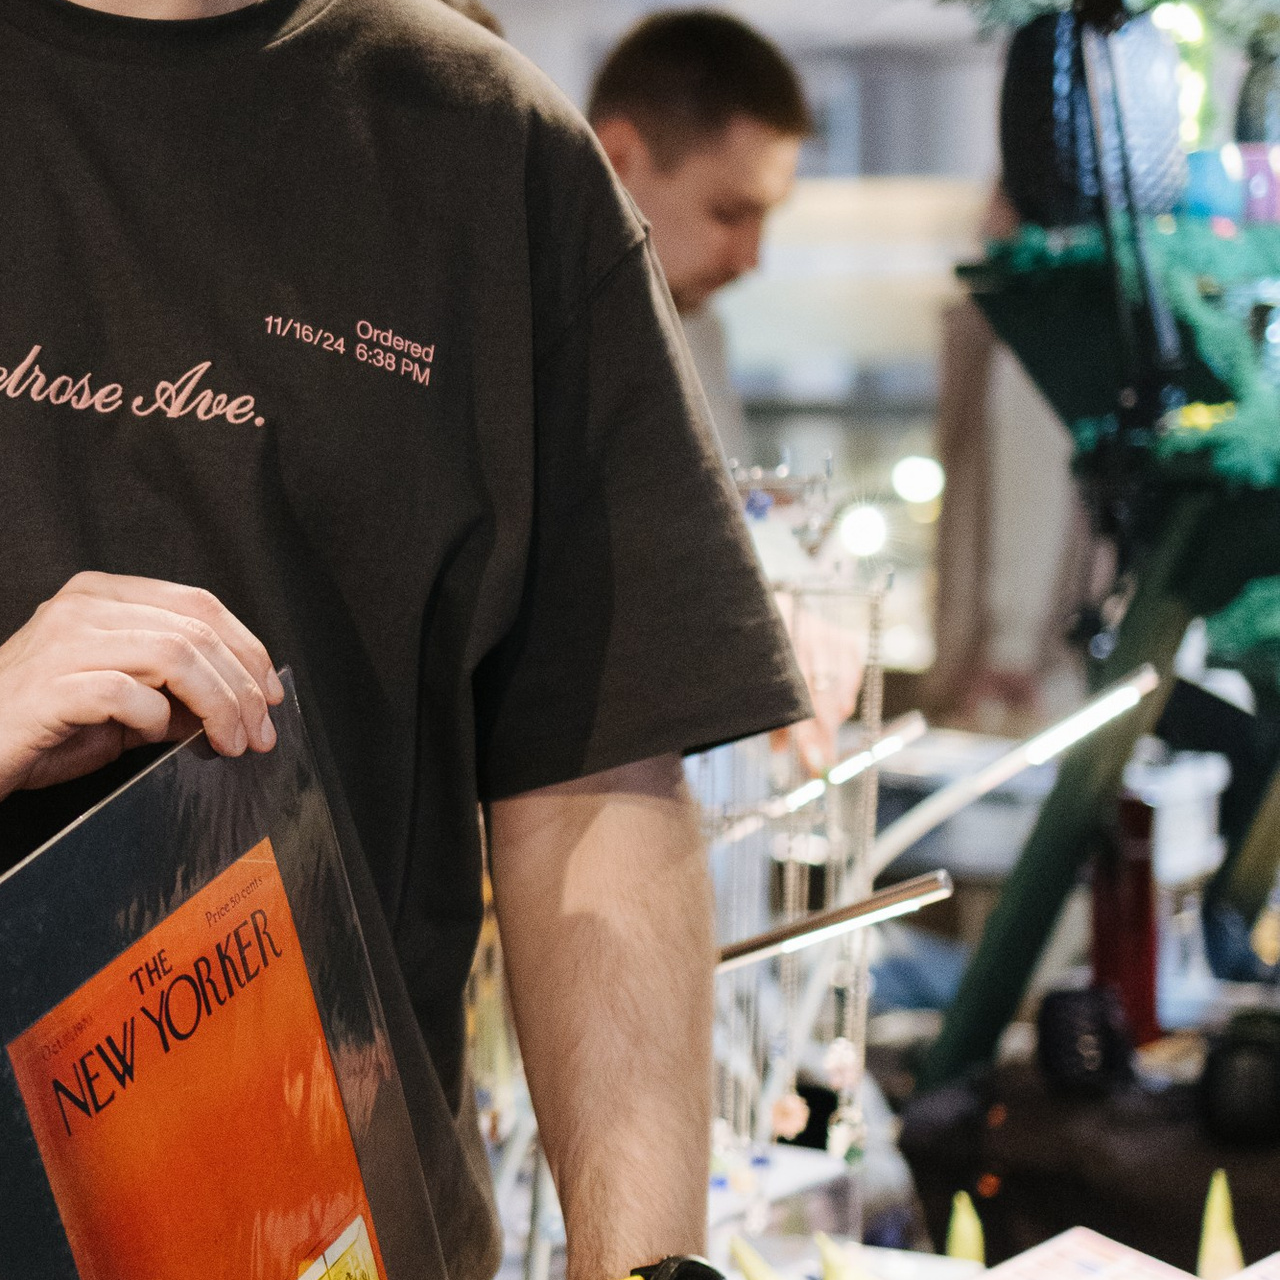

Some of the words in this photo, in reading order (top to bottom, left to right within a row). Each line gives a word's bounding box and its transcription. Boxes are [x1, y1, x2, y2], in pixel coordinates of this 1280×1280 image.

[264, 315, 346, 355] 11/16/24
[356, 320, 435, 363] Ordered
[355, 342, 397, 372] 6:38
[400, 357, 431, 386] PM
[130, 360, 266, 427] Ave.
[204, 902, 230, 929] Price
[228, 892, 241, 909] 50
[240, 875, 264, 899] cents
[129, 949, 173, 995] THE
[52, 1016, 136, 1137] NEW
[140, 908, 283, 1053] YORKER
